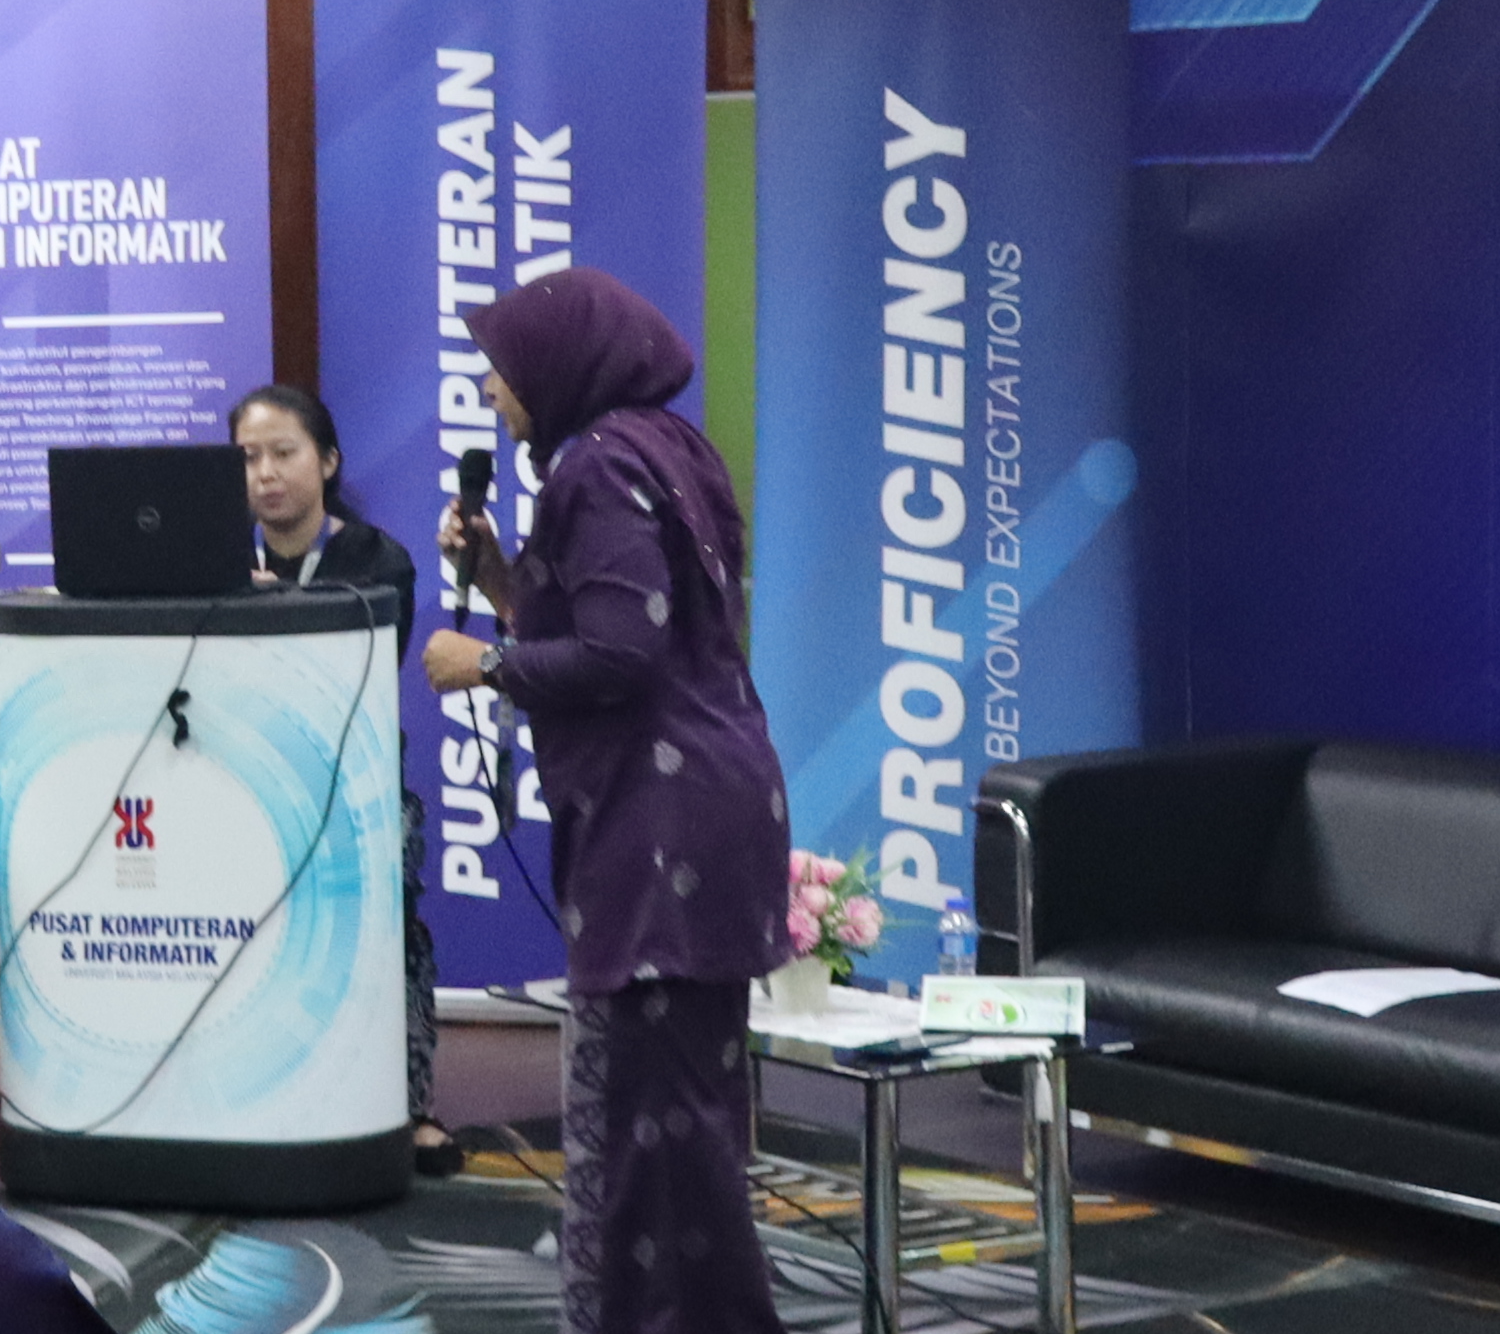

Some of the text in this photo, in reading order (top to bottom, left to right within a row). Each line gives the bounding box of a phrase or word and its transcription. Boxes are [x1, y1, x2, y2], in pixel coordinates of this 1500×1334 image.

[15, 220, 227, 268] INFORMATIK
[437, 48, 501, 900] PUSA KMPUTERAN
[881, 86, 969, 914] PROFICIENCY
[985, 241, 1022, 762] BEYOND EXPECTATIONS
[30, 912, 255, 940] PUSAT KOMPUTERAN
[61, 941, 218, 966] & INFORMATIK
